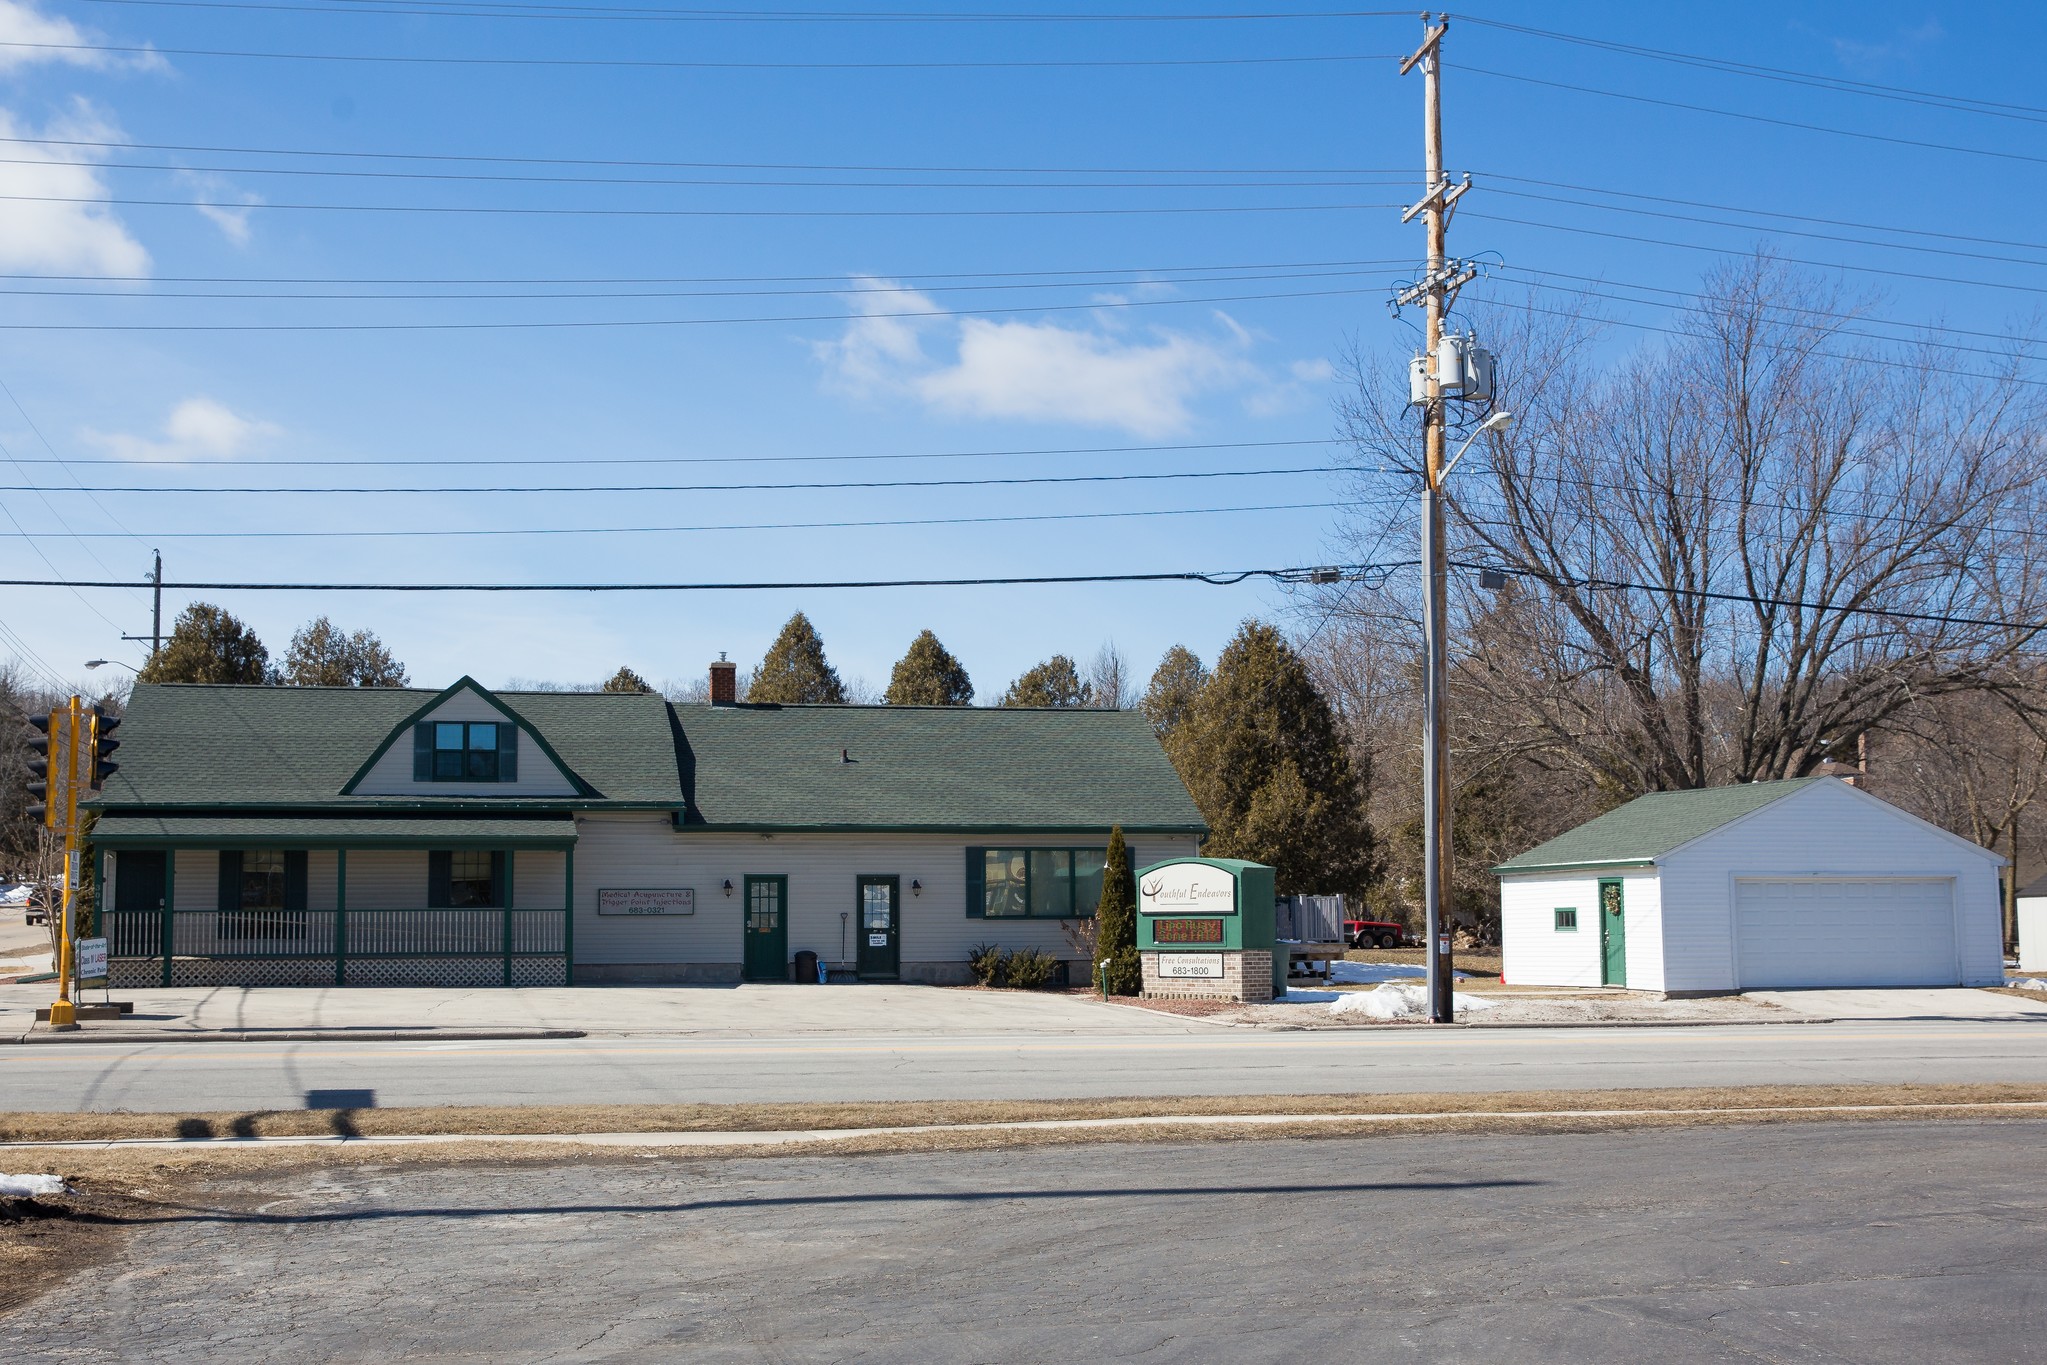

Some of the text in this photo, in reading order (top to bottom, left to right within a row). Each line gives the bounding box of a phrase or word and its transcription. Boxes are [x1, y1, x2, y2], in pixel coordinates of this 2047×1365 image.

[1142, 875, 1231, 903] Youthful Endeavors
[633, 891, 682, 899] Acupuncture
[653, 898, 691, 906] Injections
[1159, 920, 1182, 931] Lipo
[1161, 956, 1220, 965] Free Consultations
[1172, 966, 1209, 975] 683-1800
